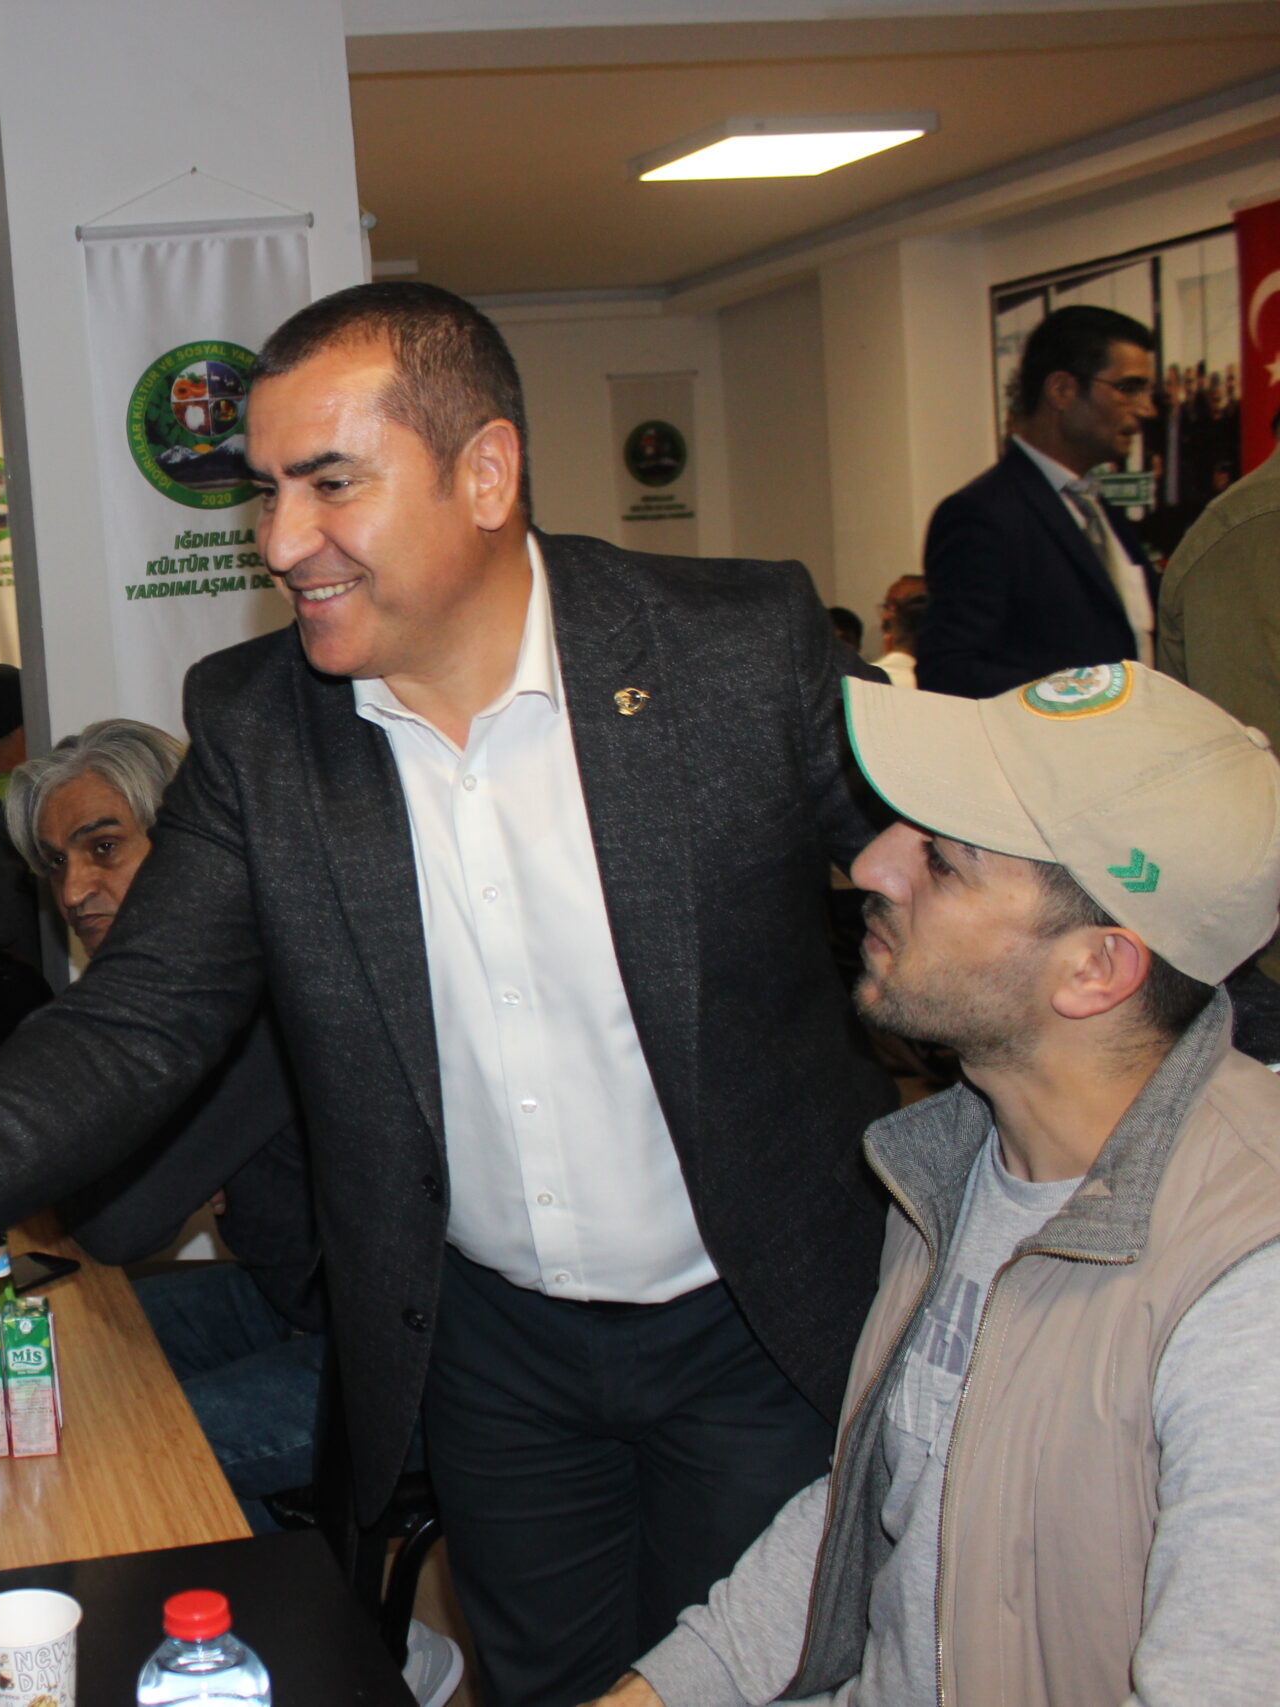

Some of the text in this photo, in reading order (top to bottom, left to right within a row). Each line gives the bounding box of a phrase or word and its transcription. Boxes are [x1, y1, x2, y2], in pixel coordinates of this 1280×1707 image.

[201, 493, 232, 505] 2020
[146, 552, 265, 576] KÜLTÜR VE SO
[125, 576, 246, 600] YARDIMLAŞMA
